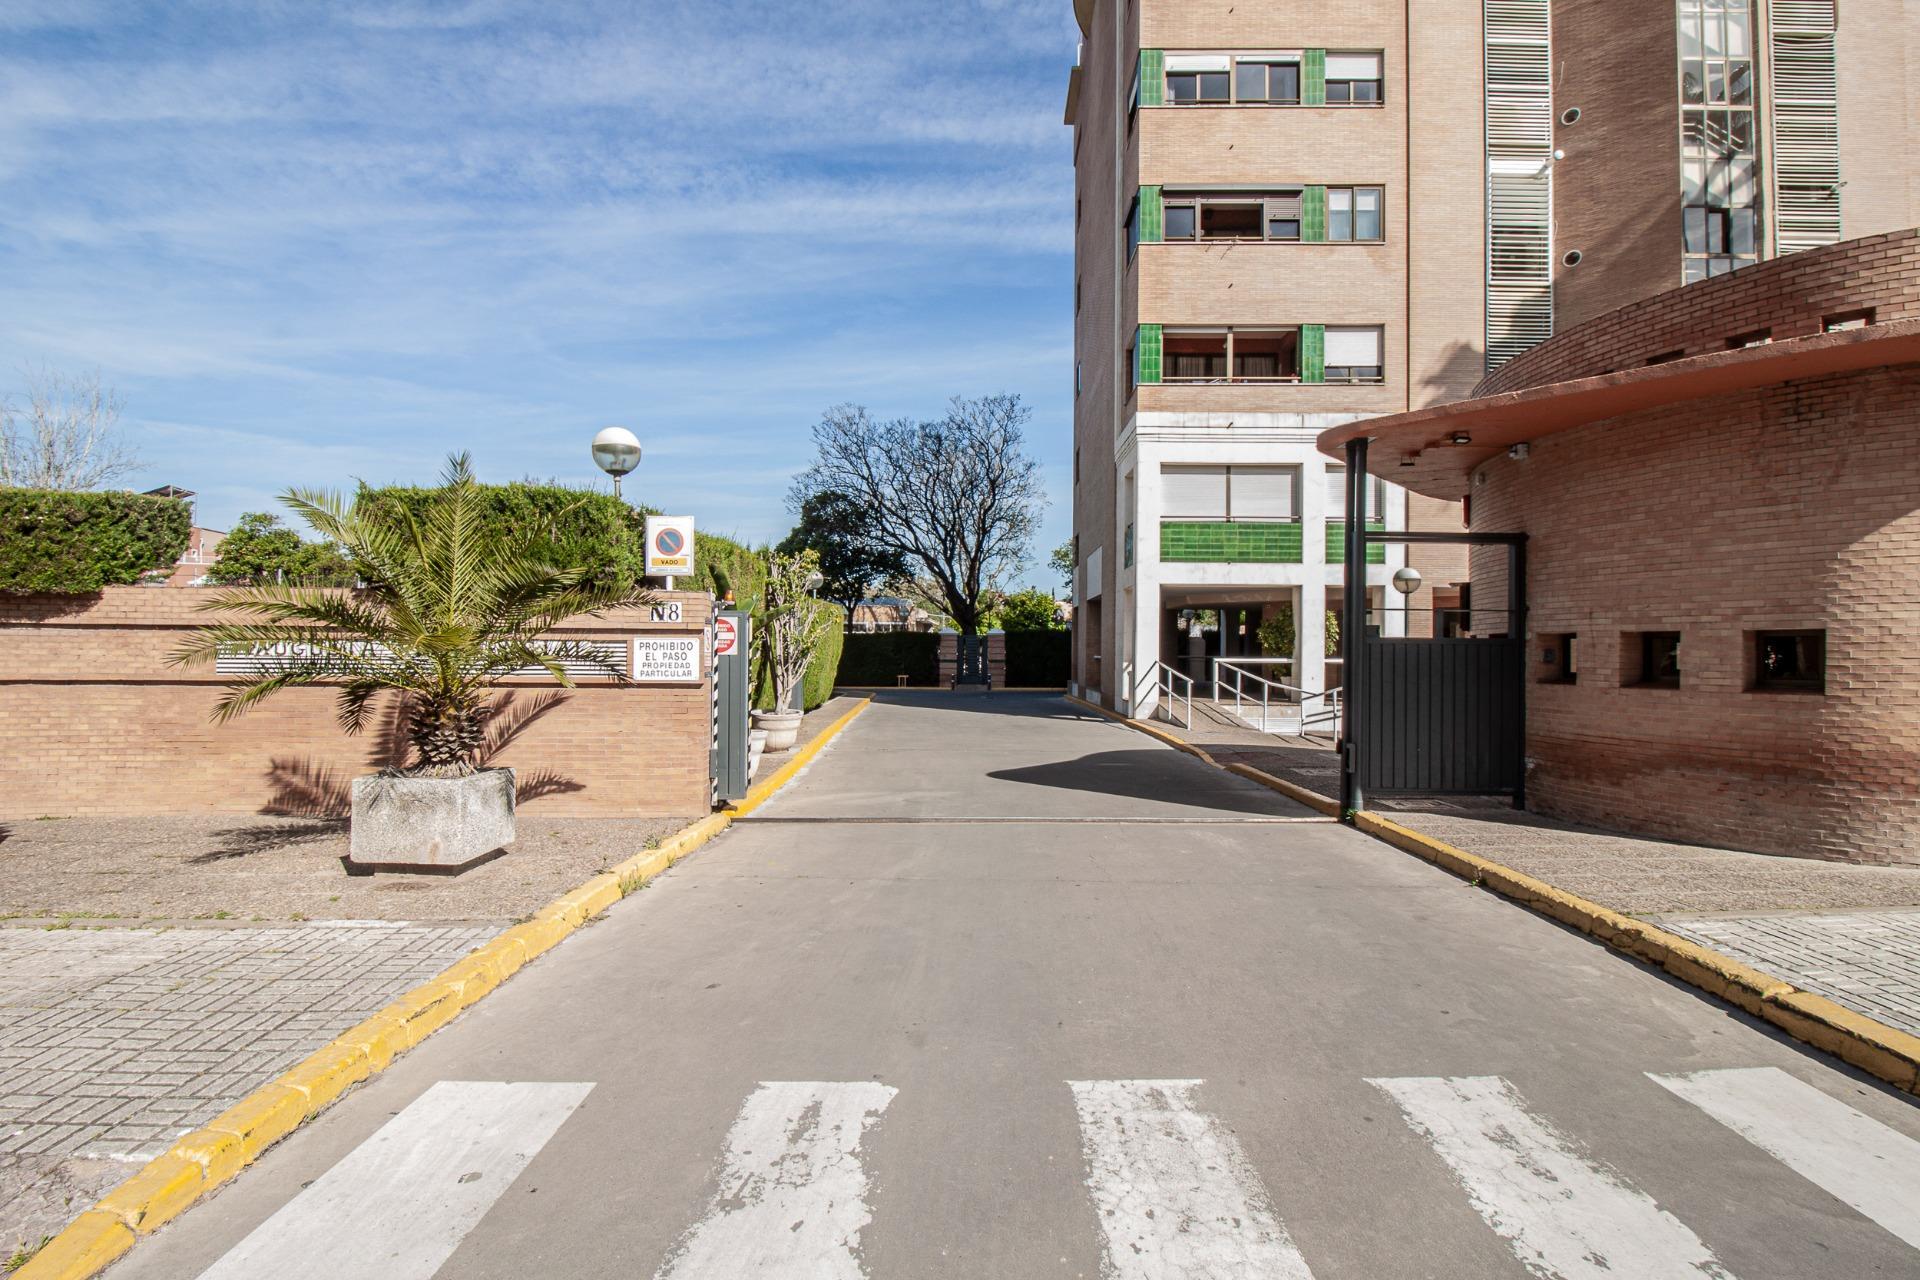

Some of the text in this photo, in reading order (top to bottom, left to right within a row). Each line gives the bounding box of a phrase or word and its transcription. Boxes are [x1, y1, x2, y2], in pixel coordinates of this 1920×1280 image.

[639, 641, 694, 651] PROHIBIDO
[645, 652, 688, 661] EL PASO
[640, 670, 692, 678] PARTICULAR
